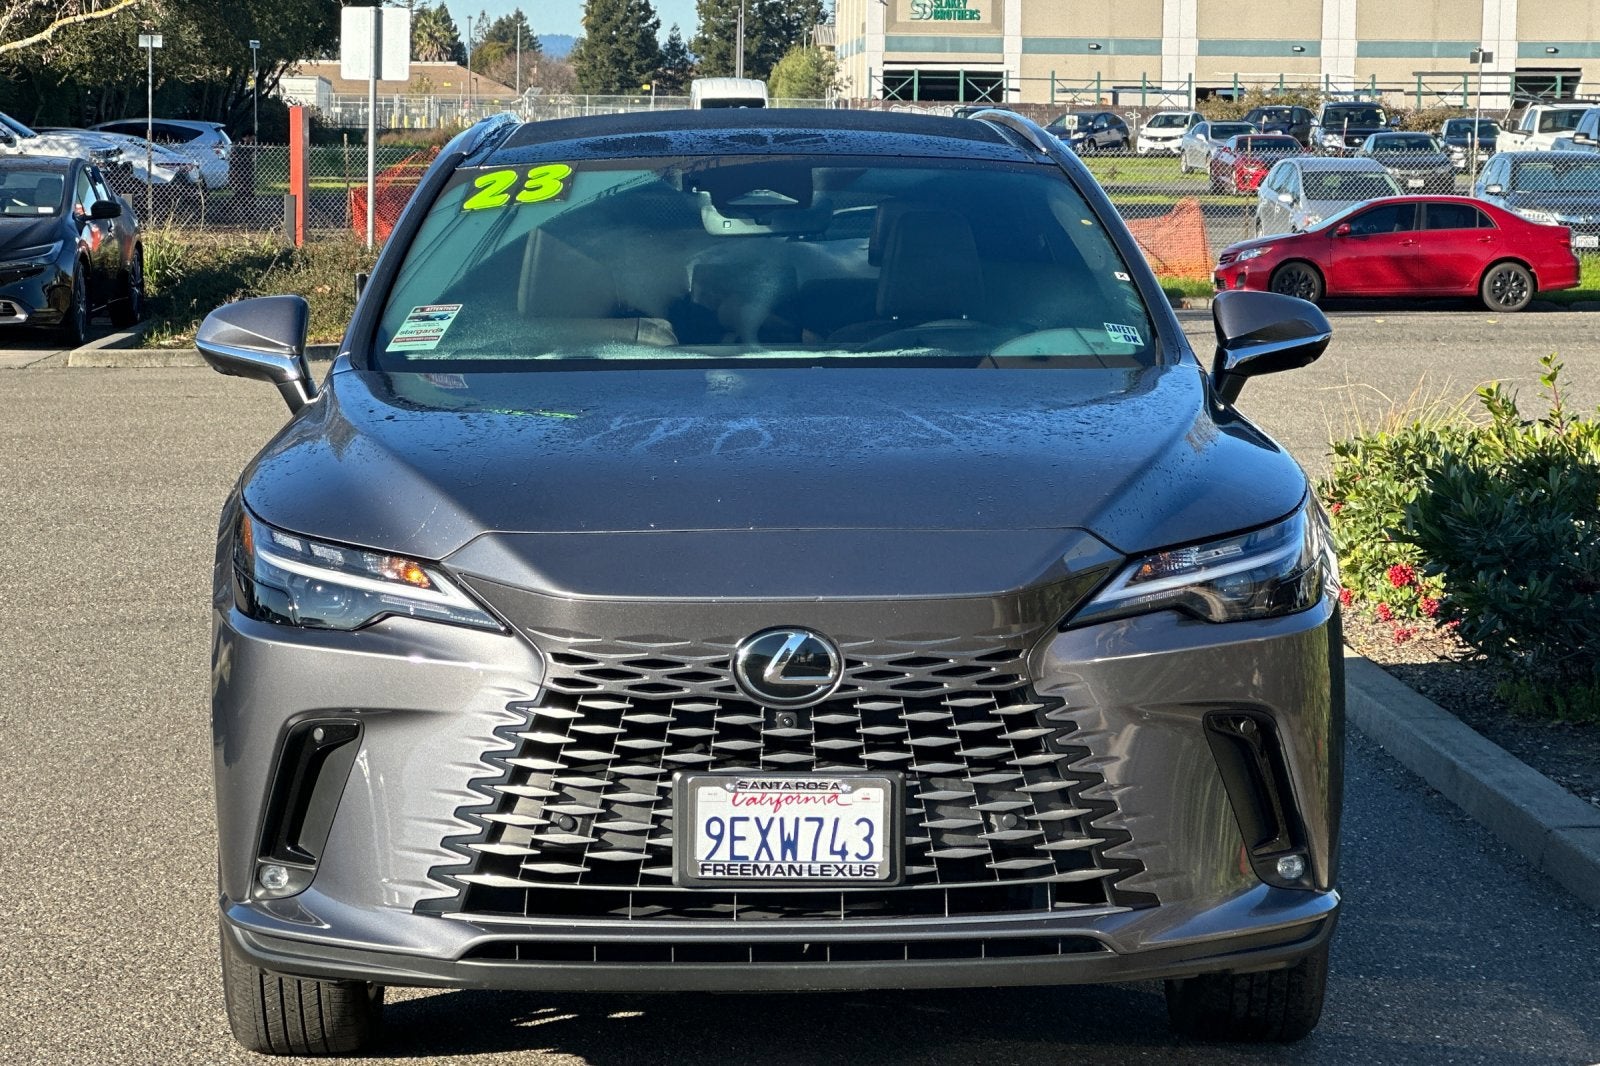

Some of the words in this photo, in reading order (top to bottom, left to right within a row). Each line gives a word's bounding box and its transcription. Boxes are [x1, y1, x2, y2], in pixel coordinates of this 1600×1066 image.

[934, 0, 968, 8] SLAKEY
[934, 9, 981, 20] BROTHERS
[463, 164, 572, 210] 23
[1105, 324, 1136, 335] SAFETY
[1123, 335, 1140, 343] OK
[737, 781, 791, 791] SANTA
[795, 781, 841, 791] ROSA
[731, 792, 853, 813] California
[705, 816, 875, 861] 9EXW743
[700, 863, 803, 877] FREEMAN
[808, 863, 877, 877] LEXUS
